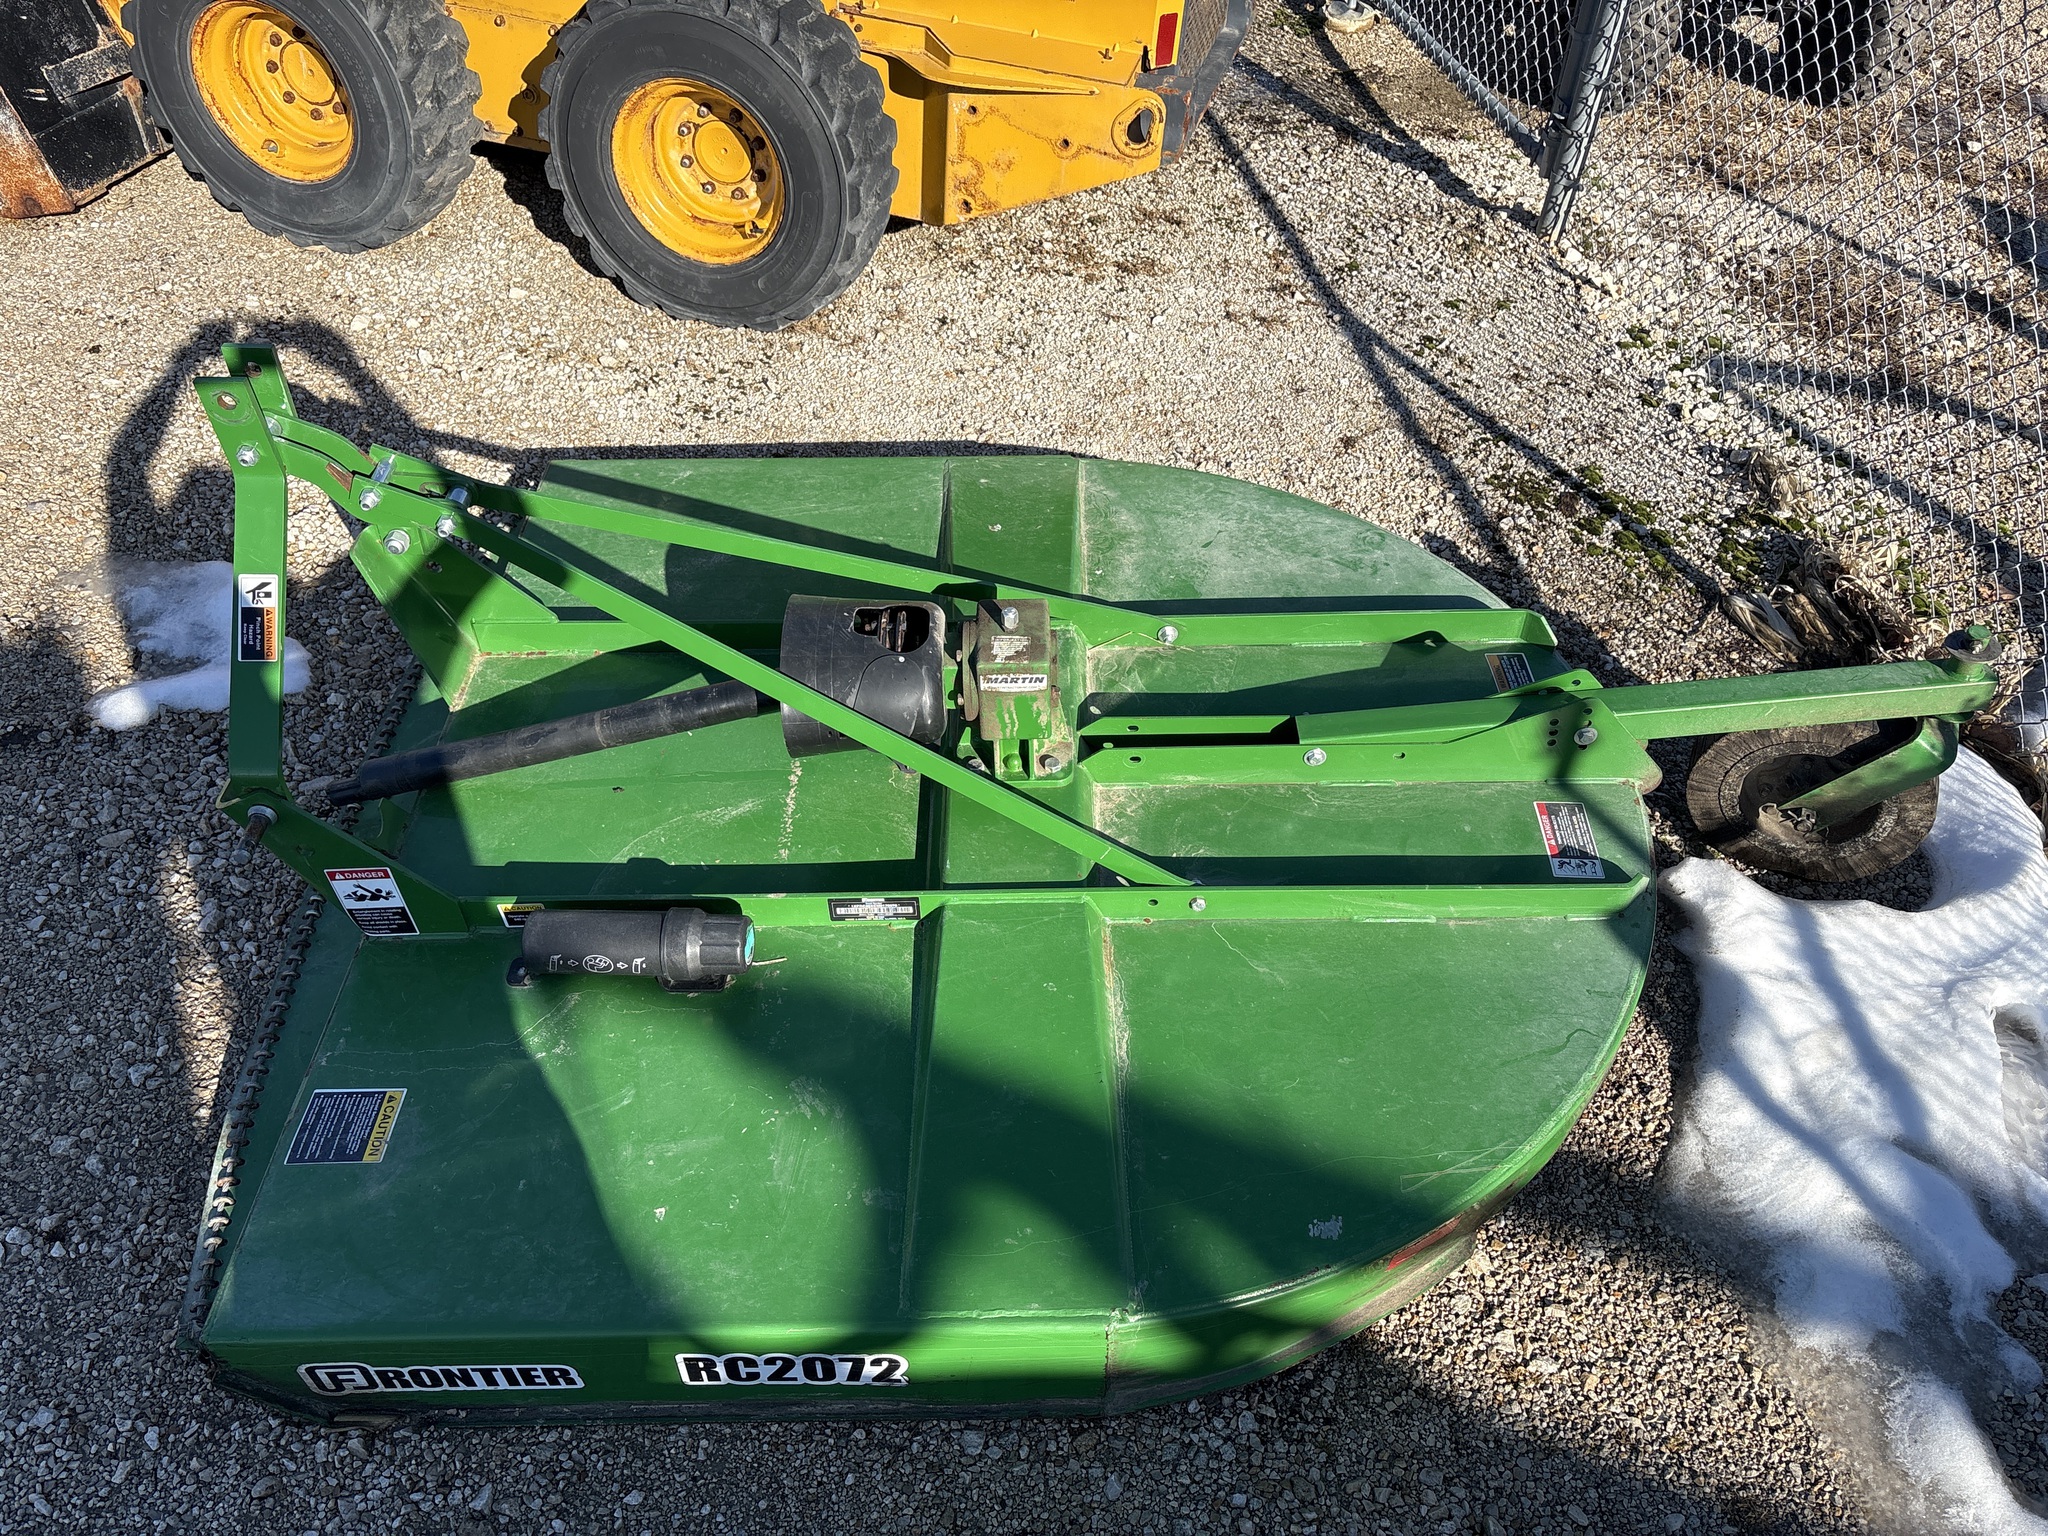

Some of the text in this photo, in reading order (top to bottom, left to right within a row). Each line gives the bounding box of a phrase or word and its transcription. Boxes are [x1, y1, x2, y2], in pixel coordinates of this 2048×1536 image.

[266, 617, 274, 657] WARNING
[986, 676, 1045, 684] MARTIN
[1541, 815, 1553, 839] DANGER
[344, 871, 385, 879] DANGER
[368, 1105, 395, 1157] CAUTION
[303, 1356, 906, 1394] FRONTIER RC2072
